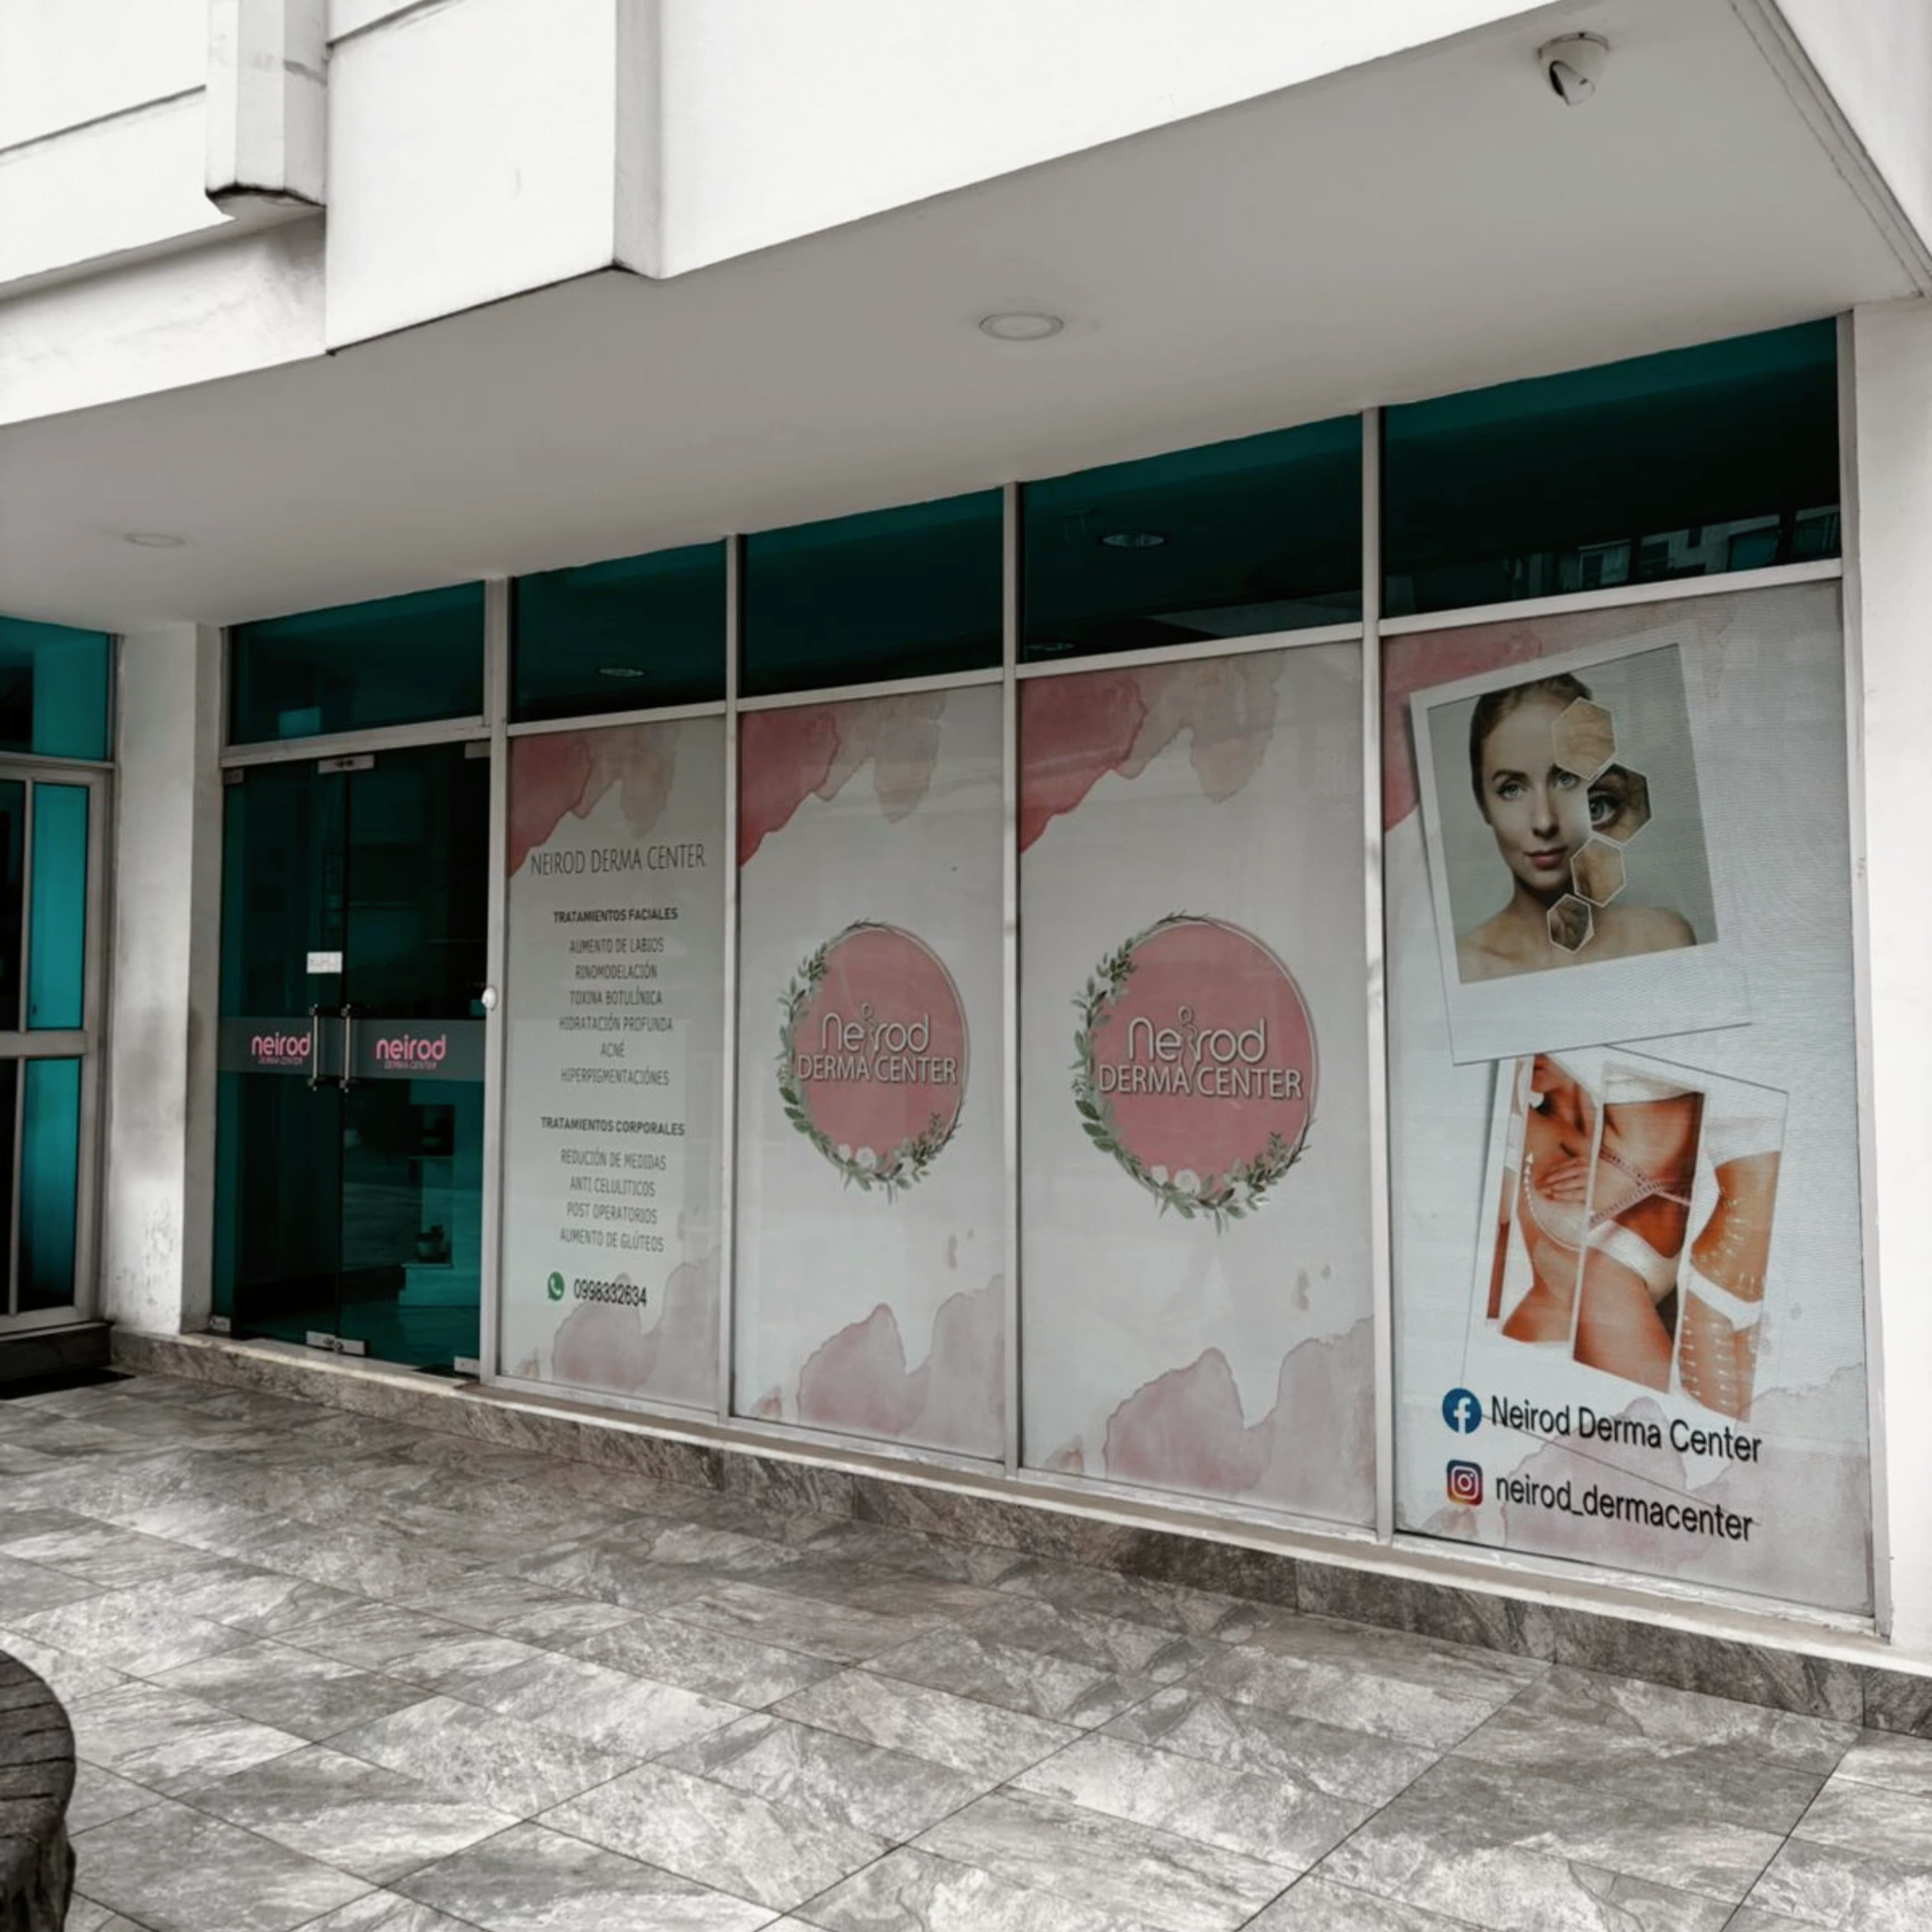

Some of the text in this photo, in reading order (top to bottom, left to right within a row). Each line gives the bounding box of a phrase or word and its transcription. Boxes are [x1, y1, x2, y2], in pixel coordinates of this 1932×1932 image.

[530, 844, 706, 876] NEIROD DERMA CENTER
[553, 907, 678, 923] TRATAMIENTOS FACIALES
[569, 939, 614, 954] AUMENTO
[616, 939, 628, 953] DE
[251, 1032, 311, 1056] neirod
[375, 1034, 446, 1060] neirod
[798, 1054, 958, 1084] DERMA CENTER
[1099, 1064, 1302, 1099] DERMA CENTER
[541, 1117, 685, 1136] TRATAMIENTOS CORPORALES
[610, 1152, 622, 1168] DE
[569, 1176, 592, 1192] ANTI
[567, 1201, 658, 1225] POST OPERATORIOS
[560, 1227, 603, 1247] AUMENTO
[606, 1231, 619, 1248] DE
[1491, 1396, 1761, 1464] Neirod Derma Center
[1495, 1474, 1755, 1542] neirod_dermacenter
